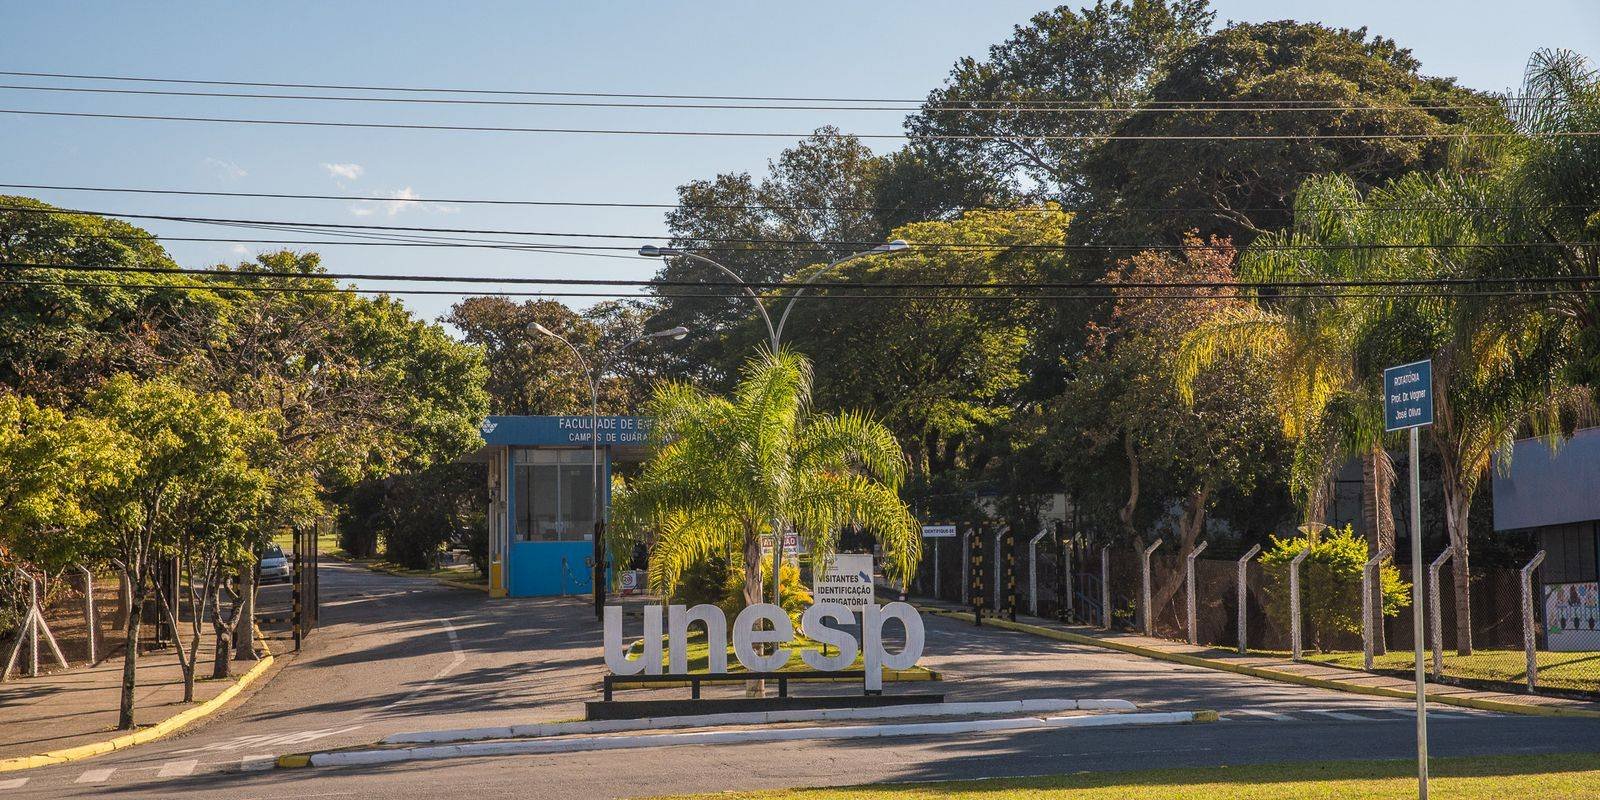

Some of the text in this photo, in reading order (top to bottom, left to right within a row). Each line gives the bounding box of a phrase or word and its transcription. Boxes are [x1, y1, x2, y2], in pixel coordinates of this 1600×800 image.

[1394, 371, 1419, 386] ROTATÓRIA
[1391, 393, 1402, 403] Prof.
[1395, 408, 1407, 420] José
[620, 419, 632, 429] DE
[568, 433, 602, 442] CAMPS
[606, 433, 617, 442] DE
[817, 574, 859, 583] VISITANTES
[817, 585, 871, 596] IDENTIFICAÇÃO
[604, 601, 925, 690] unesp
